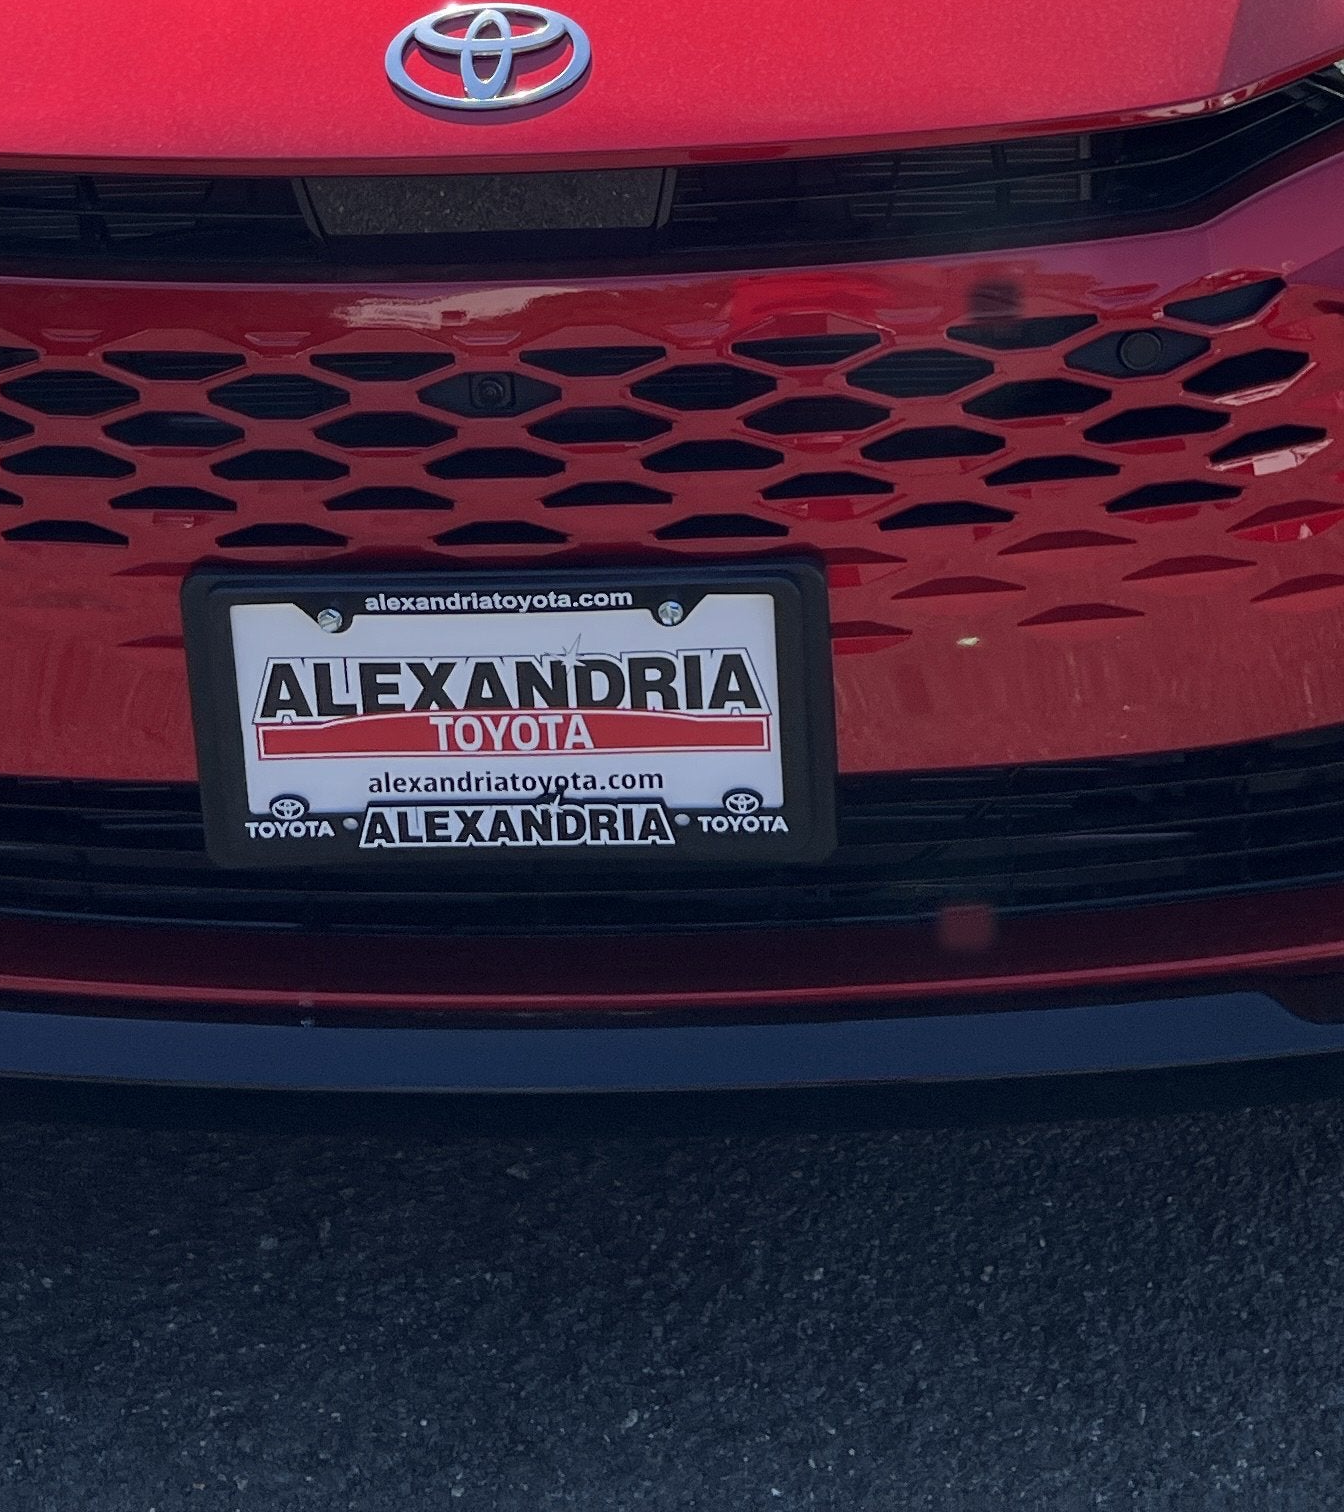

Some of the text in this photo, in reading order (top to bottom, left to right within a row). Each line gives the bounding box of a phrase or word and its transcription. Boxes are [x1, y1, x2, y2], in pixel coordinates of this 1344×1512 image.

[364, 591, 633, 613] alexandriatoyota.com
[259, 652, 763, 719] ALEXANDRIA
[429, 713, 595, 752] TOYOTA
[368, 771, 664, 794] alexandriatoyota.com
[245, 820, 336, 839] TOYOTA
[360, 805, 674, 847] ALEXANDRIA
[697, 814, 790, 833] TOYOTA
